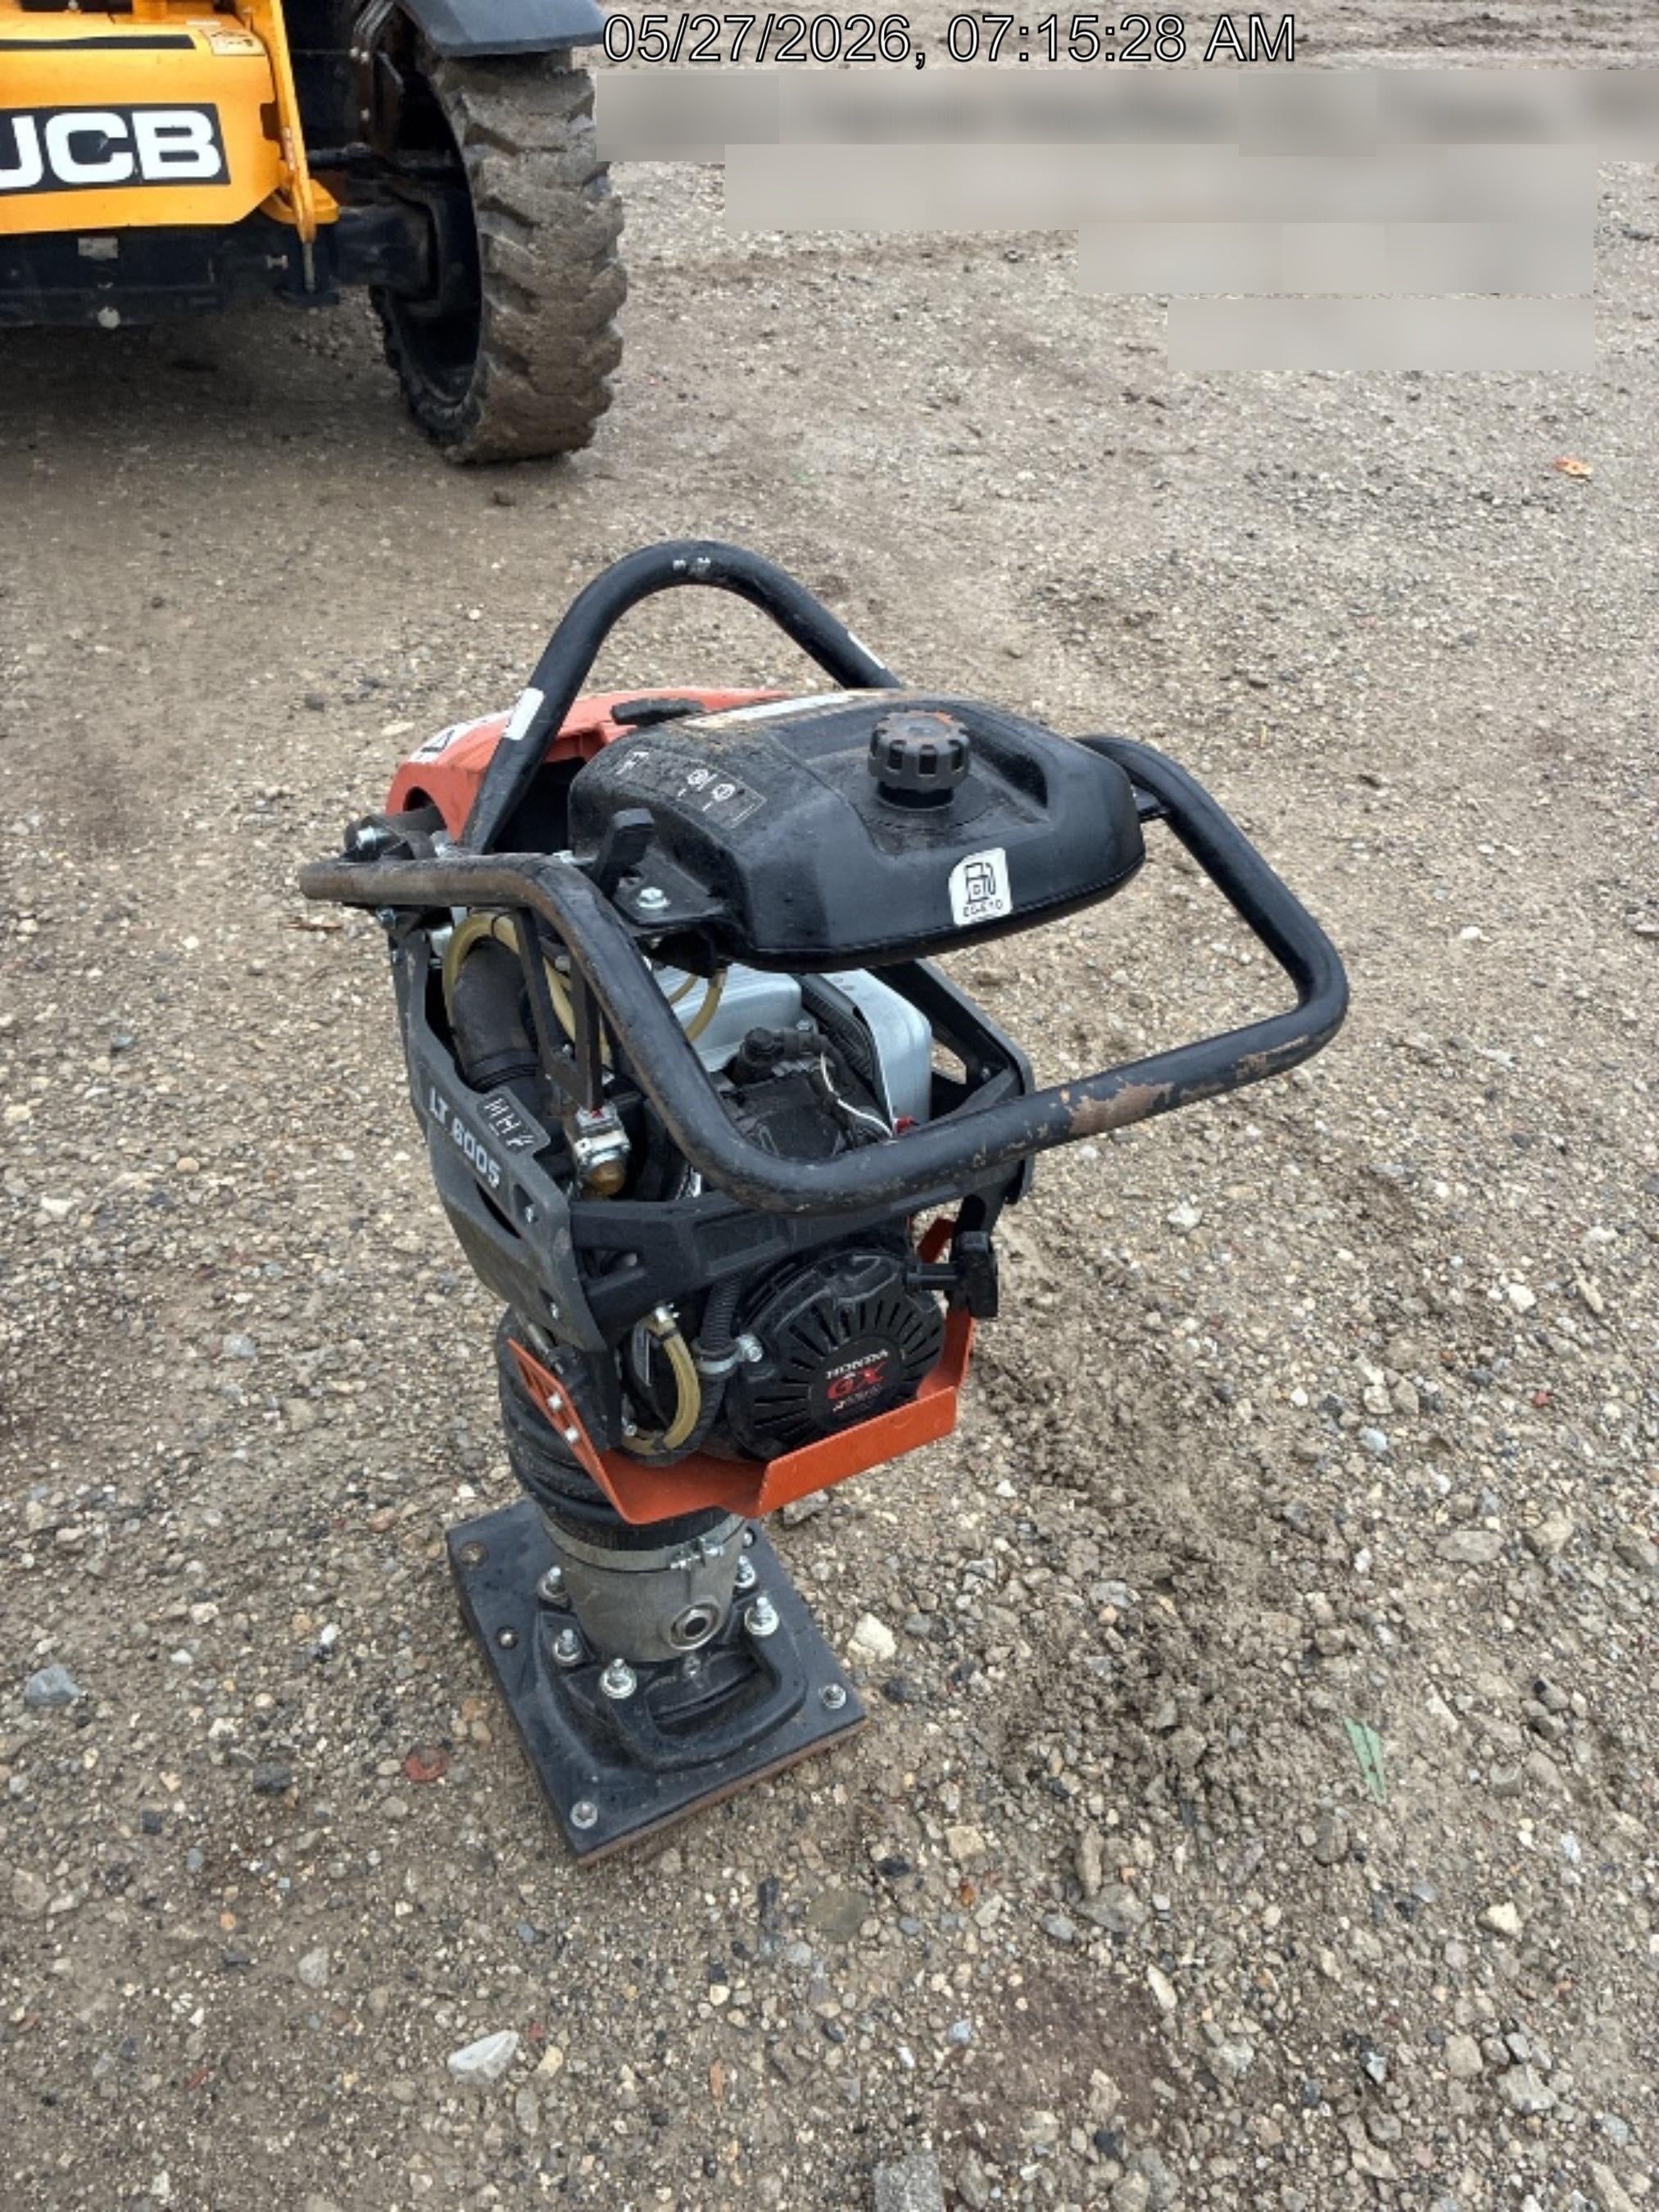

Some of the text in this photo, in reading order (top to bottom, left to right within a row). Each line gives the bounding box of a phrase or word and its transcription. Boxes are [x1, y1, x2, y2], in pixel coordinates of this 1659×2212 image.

[0, 110, 222, 190] JCB
[429, 1086, 449, 1125] LT
[826, 1348, 889, 1380] HONDA
